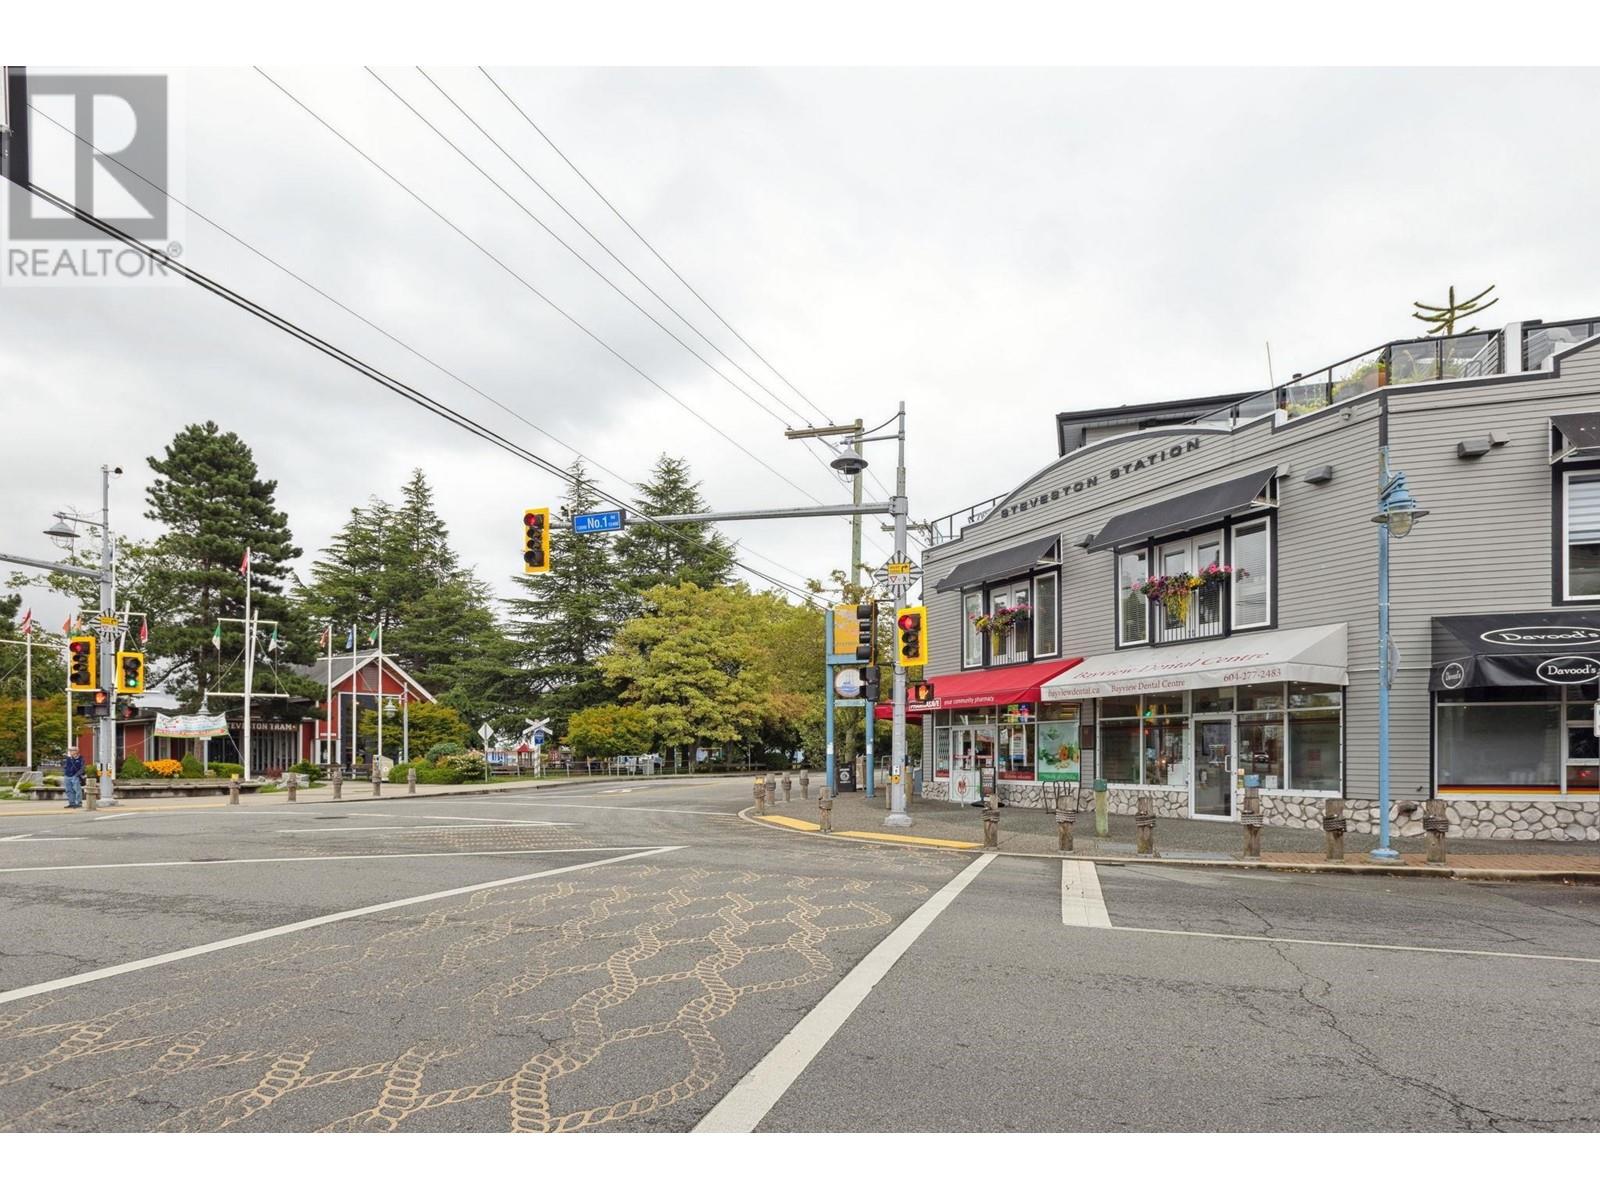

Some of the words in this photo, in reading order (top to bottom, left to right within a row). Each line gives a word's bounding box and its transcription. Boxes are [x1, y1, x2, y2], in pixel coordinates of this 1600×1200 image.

[1001, 475, 1099, 518] STEVESTON
[1110, 437, 1200, 479] STATION
[586, 515, 608, 529] No.1
[1499, 630, 1600, 641] Davood's
[1547, 664, 1597, 675] Davood's
[1111, 683, 1138, 695] Bayview
[1138, 680, 1161, 691] Dental
[1162, 678, 1185, 689] Centre
